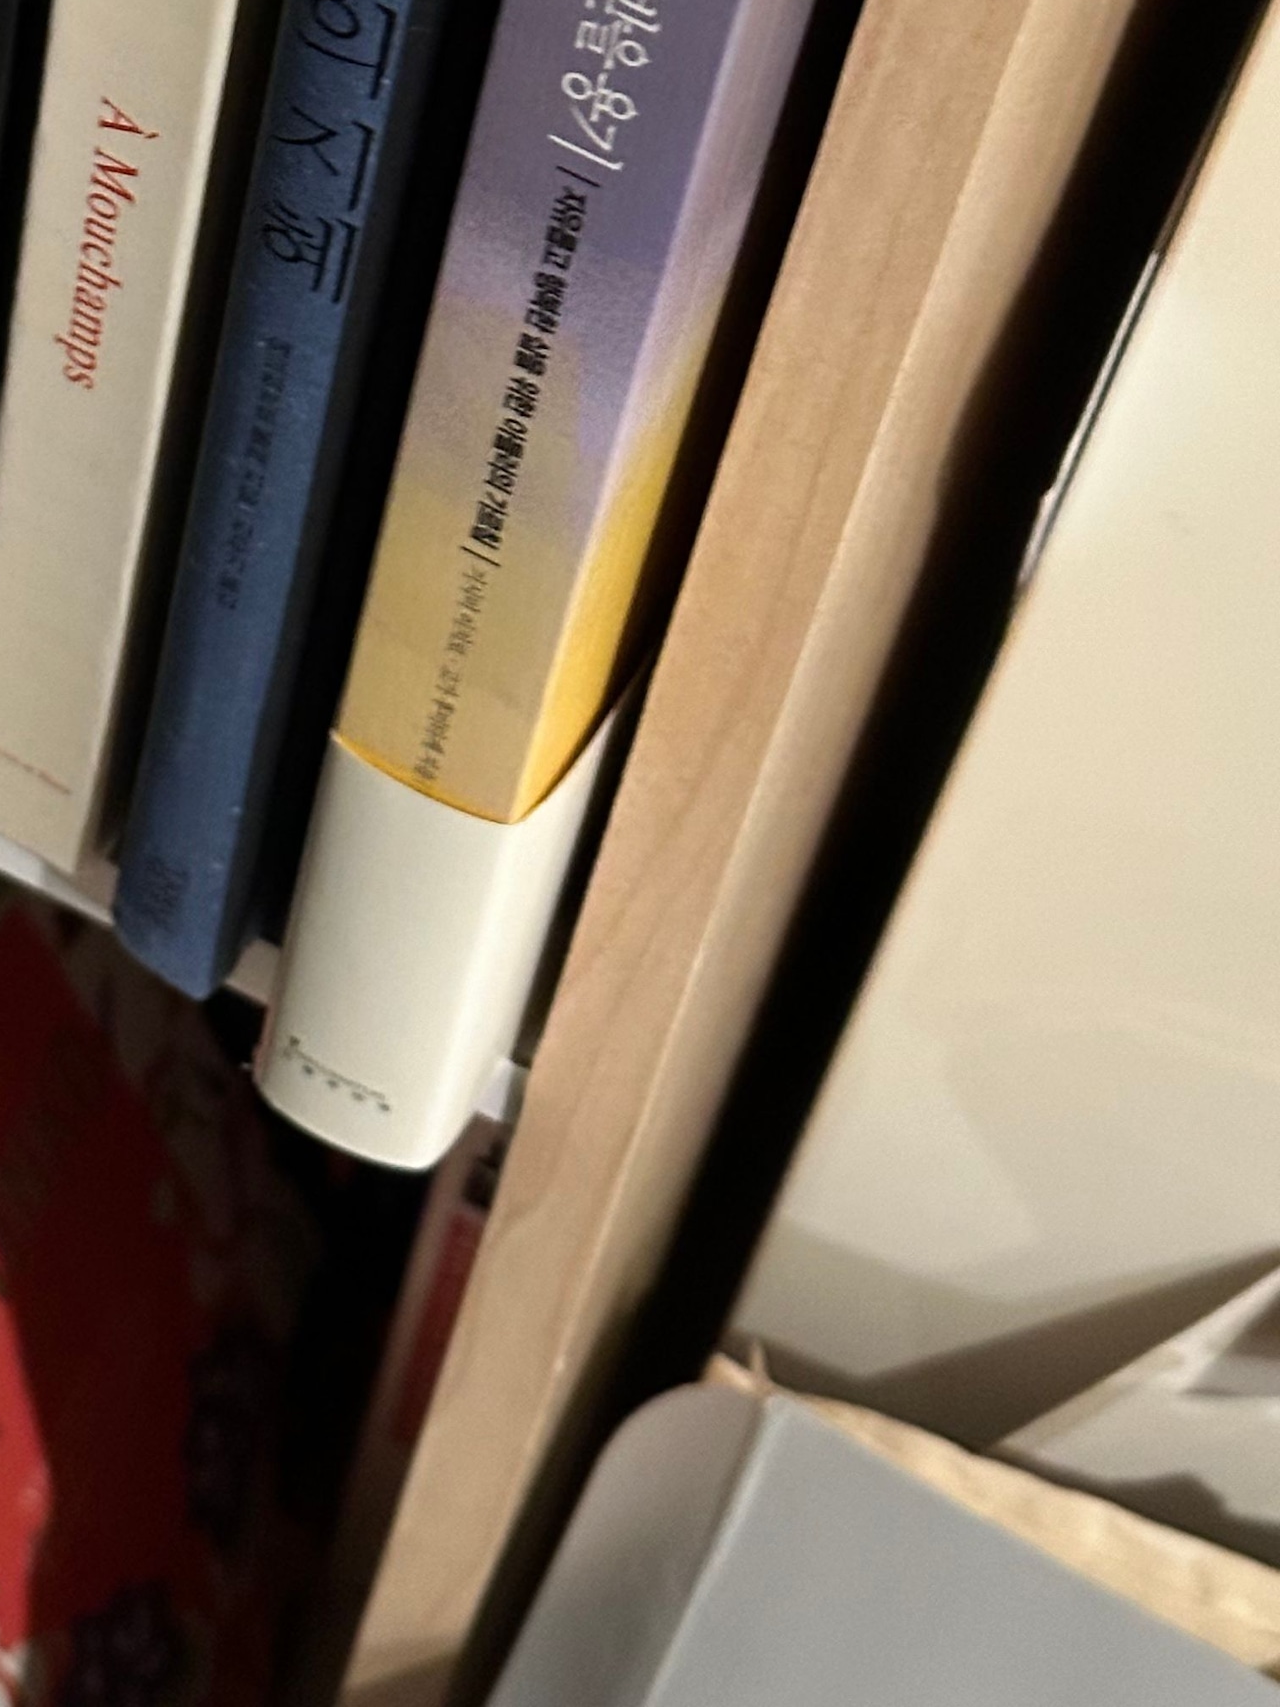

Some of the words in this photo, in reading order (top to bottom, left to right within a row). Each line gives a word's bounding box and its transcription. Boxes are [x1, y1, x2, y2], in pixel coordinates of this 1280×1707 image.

[260, 105, 374, 306] 지혜
[542, 186, 587, 271] 자유롭고
[53, 145, 140, 391] Mouchamps
[524, 271, 568, 335] 행복한
[513, 332, 551, 377] 삶을
[502, 377, 541, 419] 위한
[483, 418, 528, 496] 아들러의
